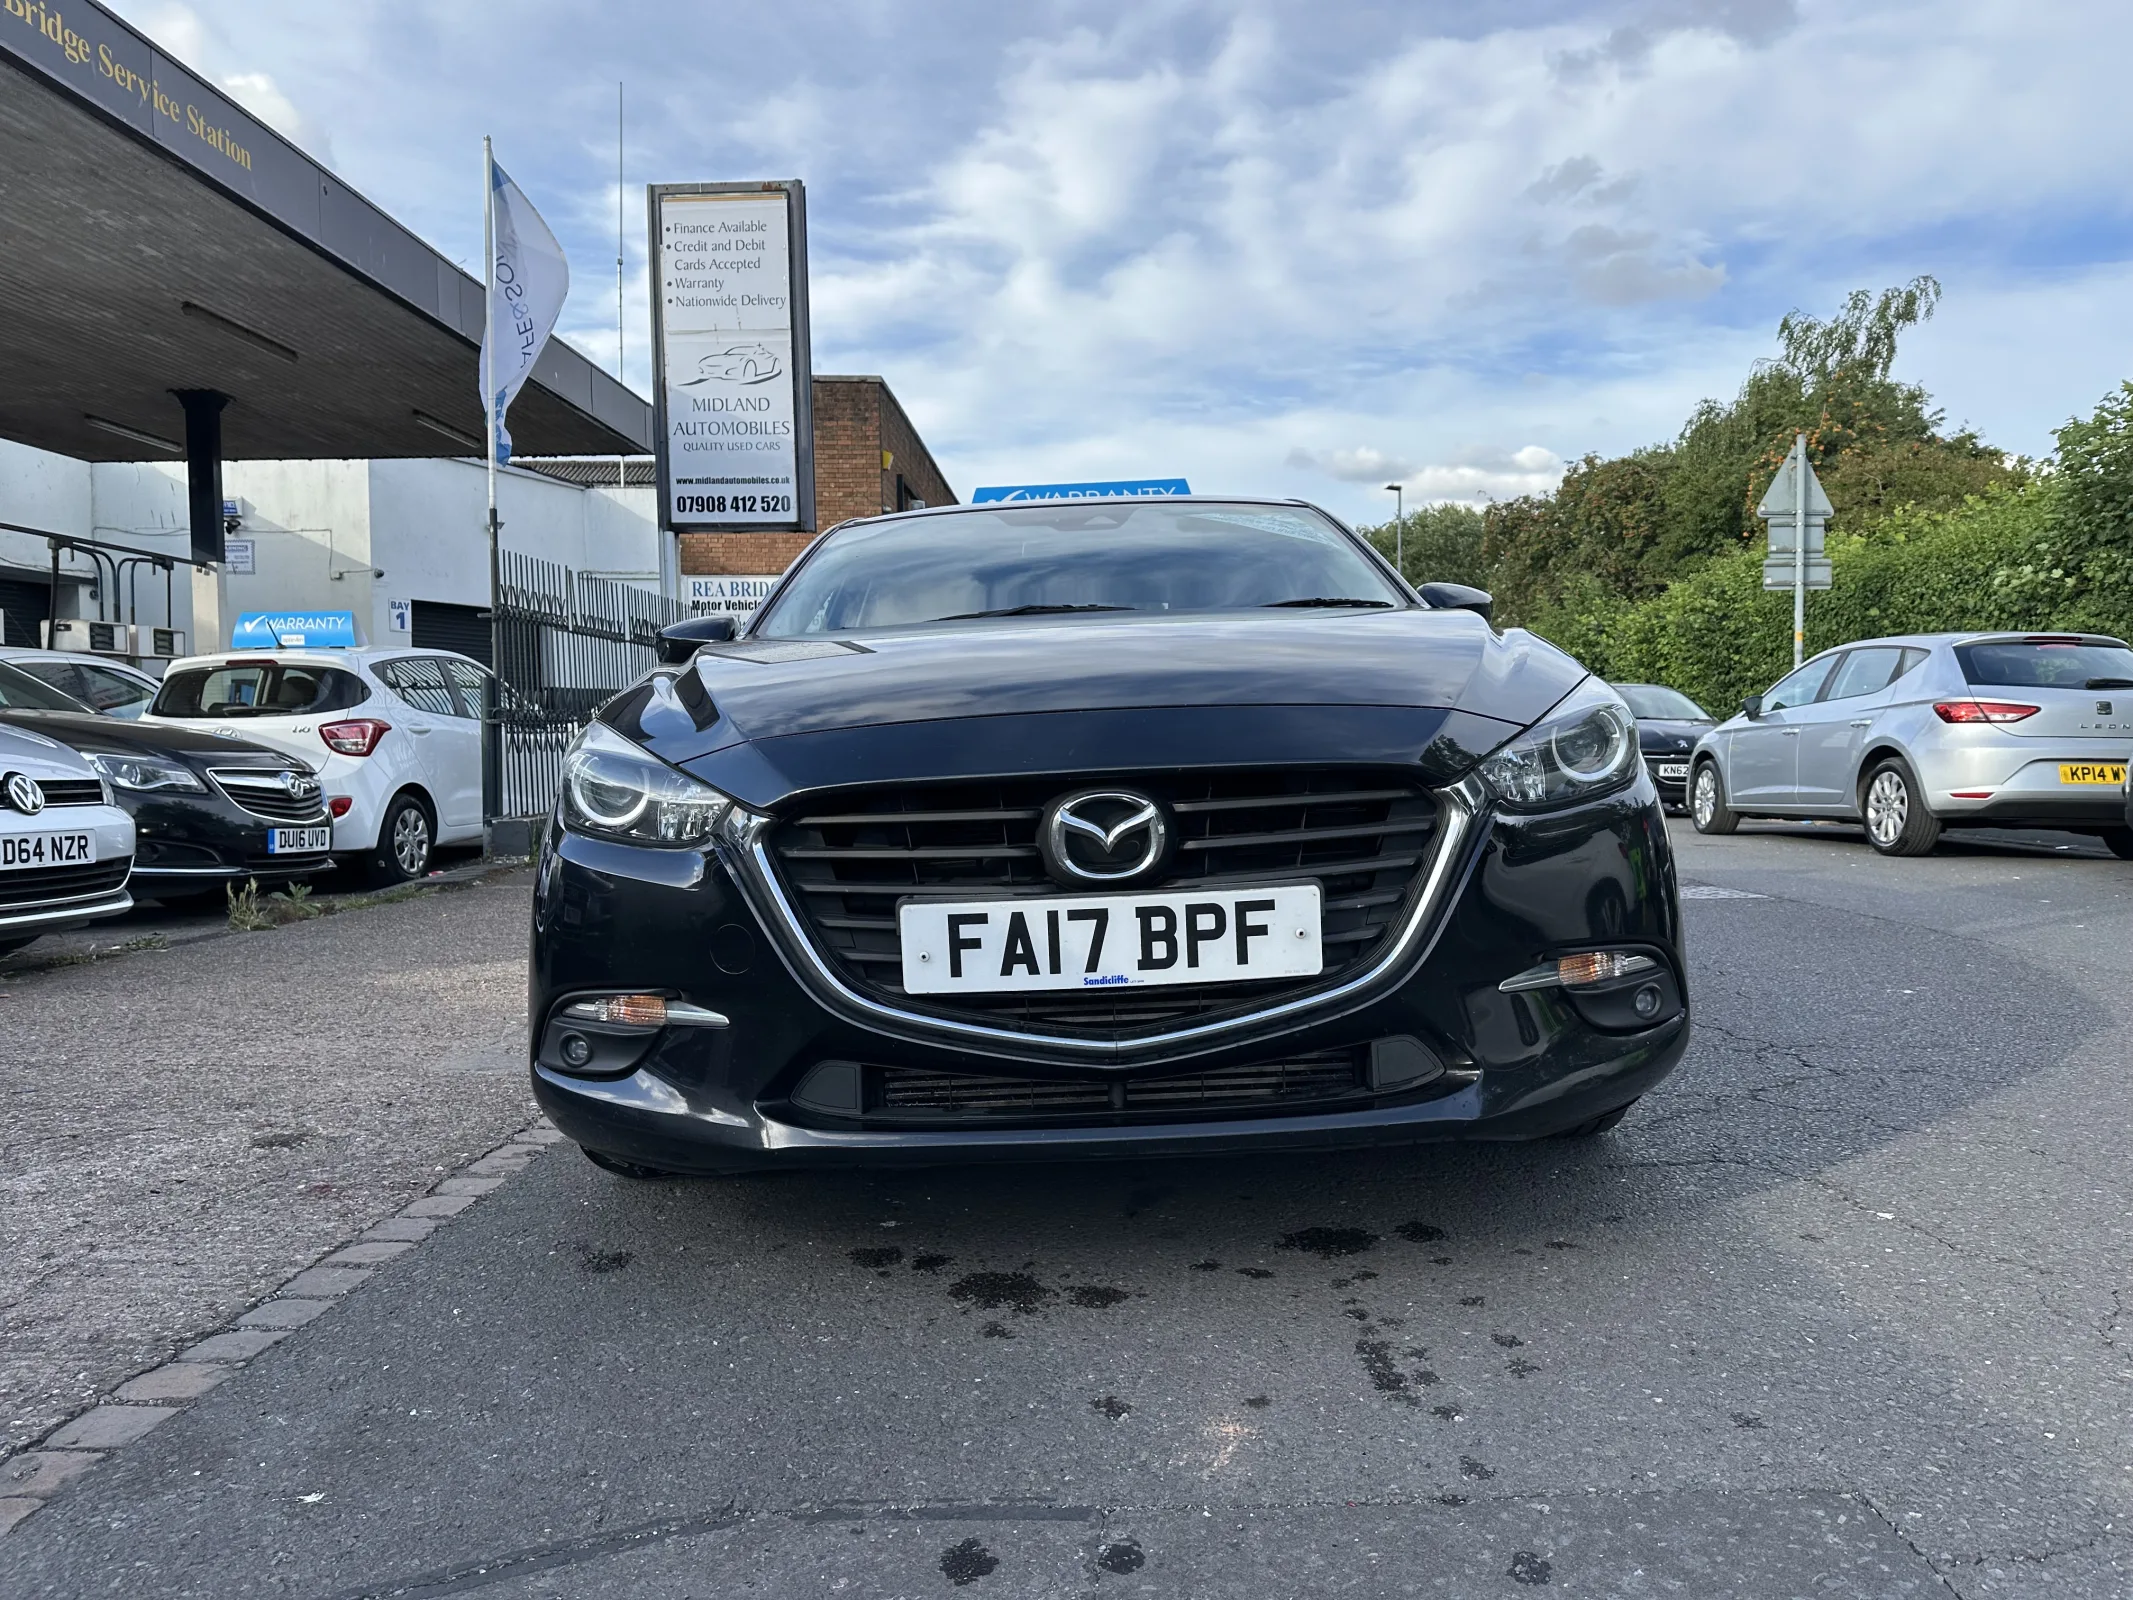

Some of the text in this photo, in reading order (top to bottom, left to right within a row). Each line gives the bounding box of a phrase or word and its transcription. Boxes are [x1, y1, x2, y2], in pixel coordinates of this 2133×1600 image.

[98, 43, 180, 122] Service
[186, 104, 252, 171] Station
[674, 219, 767, 234] Finance Available
[674, 239, 765, 252] Credit and Debit
[674, 257, 761, 273] Cards Accepted
[675, 277, 724, 292] Warranty
[675, 294, 787, 309] Nationwide Delivery
[692, 397, 770, 412] MIDLAND
[673, 421, 790, 436] AUTOMOBILES
[683, 441, 781, 452] QUALITY USED CARS
[675, 476, 790, 485] www.midlandautomobiles.co.uk
[676, 495, 791, 513] 07908 412 520
[692, 581, 726, 597] REA
[390, 600, 410, 610] BAY
[691, 600, 722, 611] Motor
[265, 616, 346, 630] WARRANTY
[395, 611, 406, 630] 1
[1663, 765, 1689, 775] KN62
[2069, 766, 2107, 781] KP14
[279, 829, 327, 849] DU16 UVD
[2, 835, 89, 865] D64 NZR
[947, 899, 1276, 978] FA17 BPF
[1083, 975, 1129, 986] Sandicliffe
